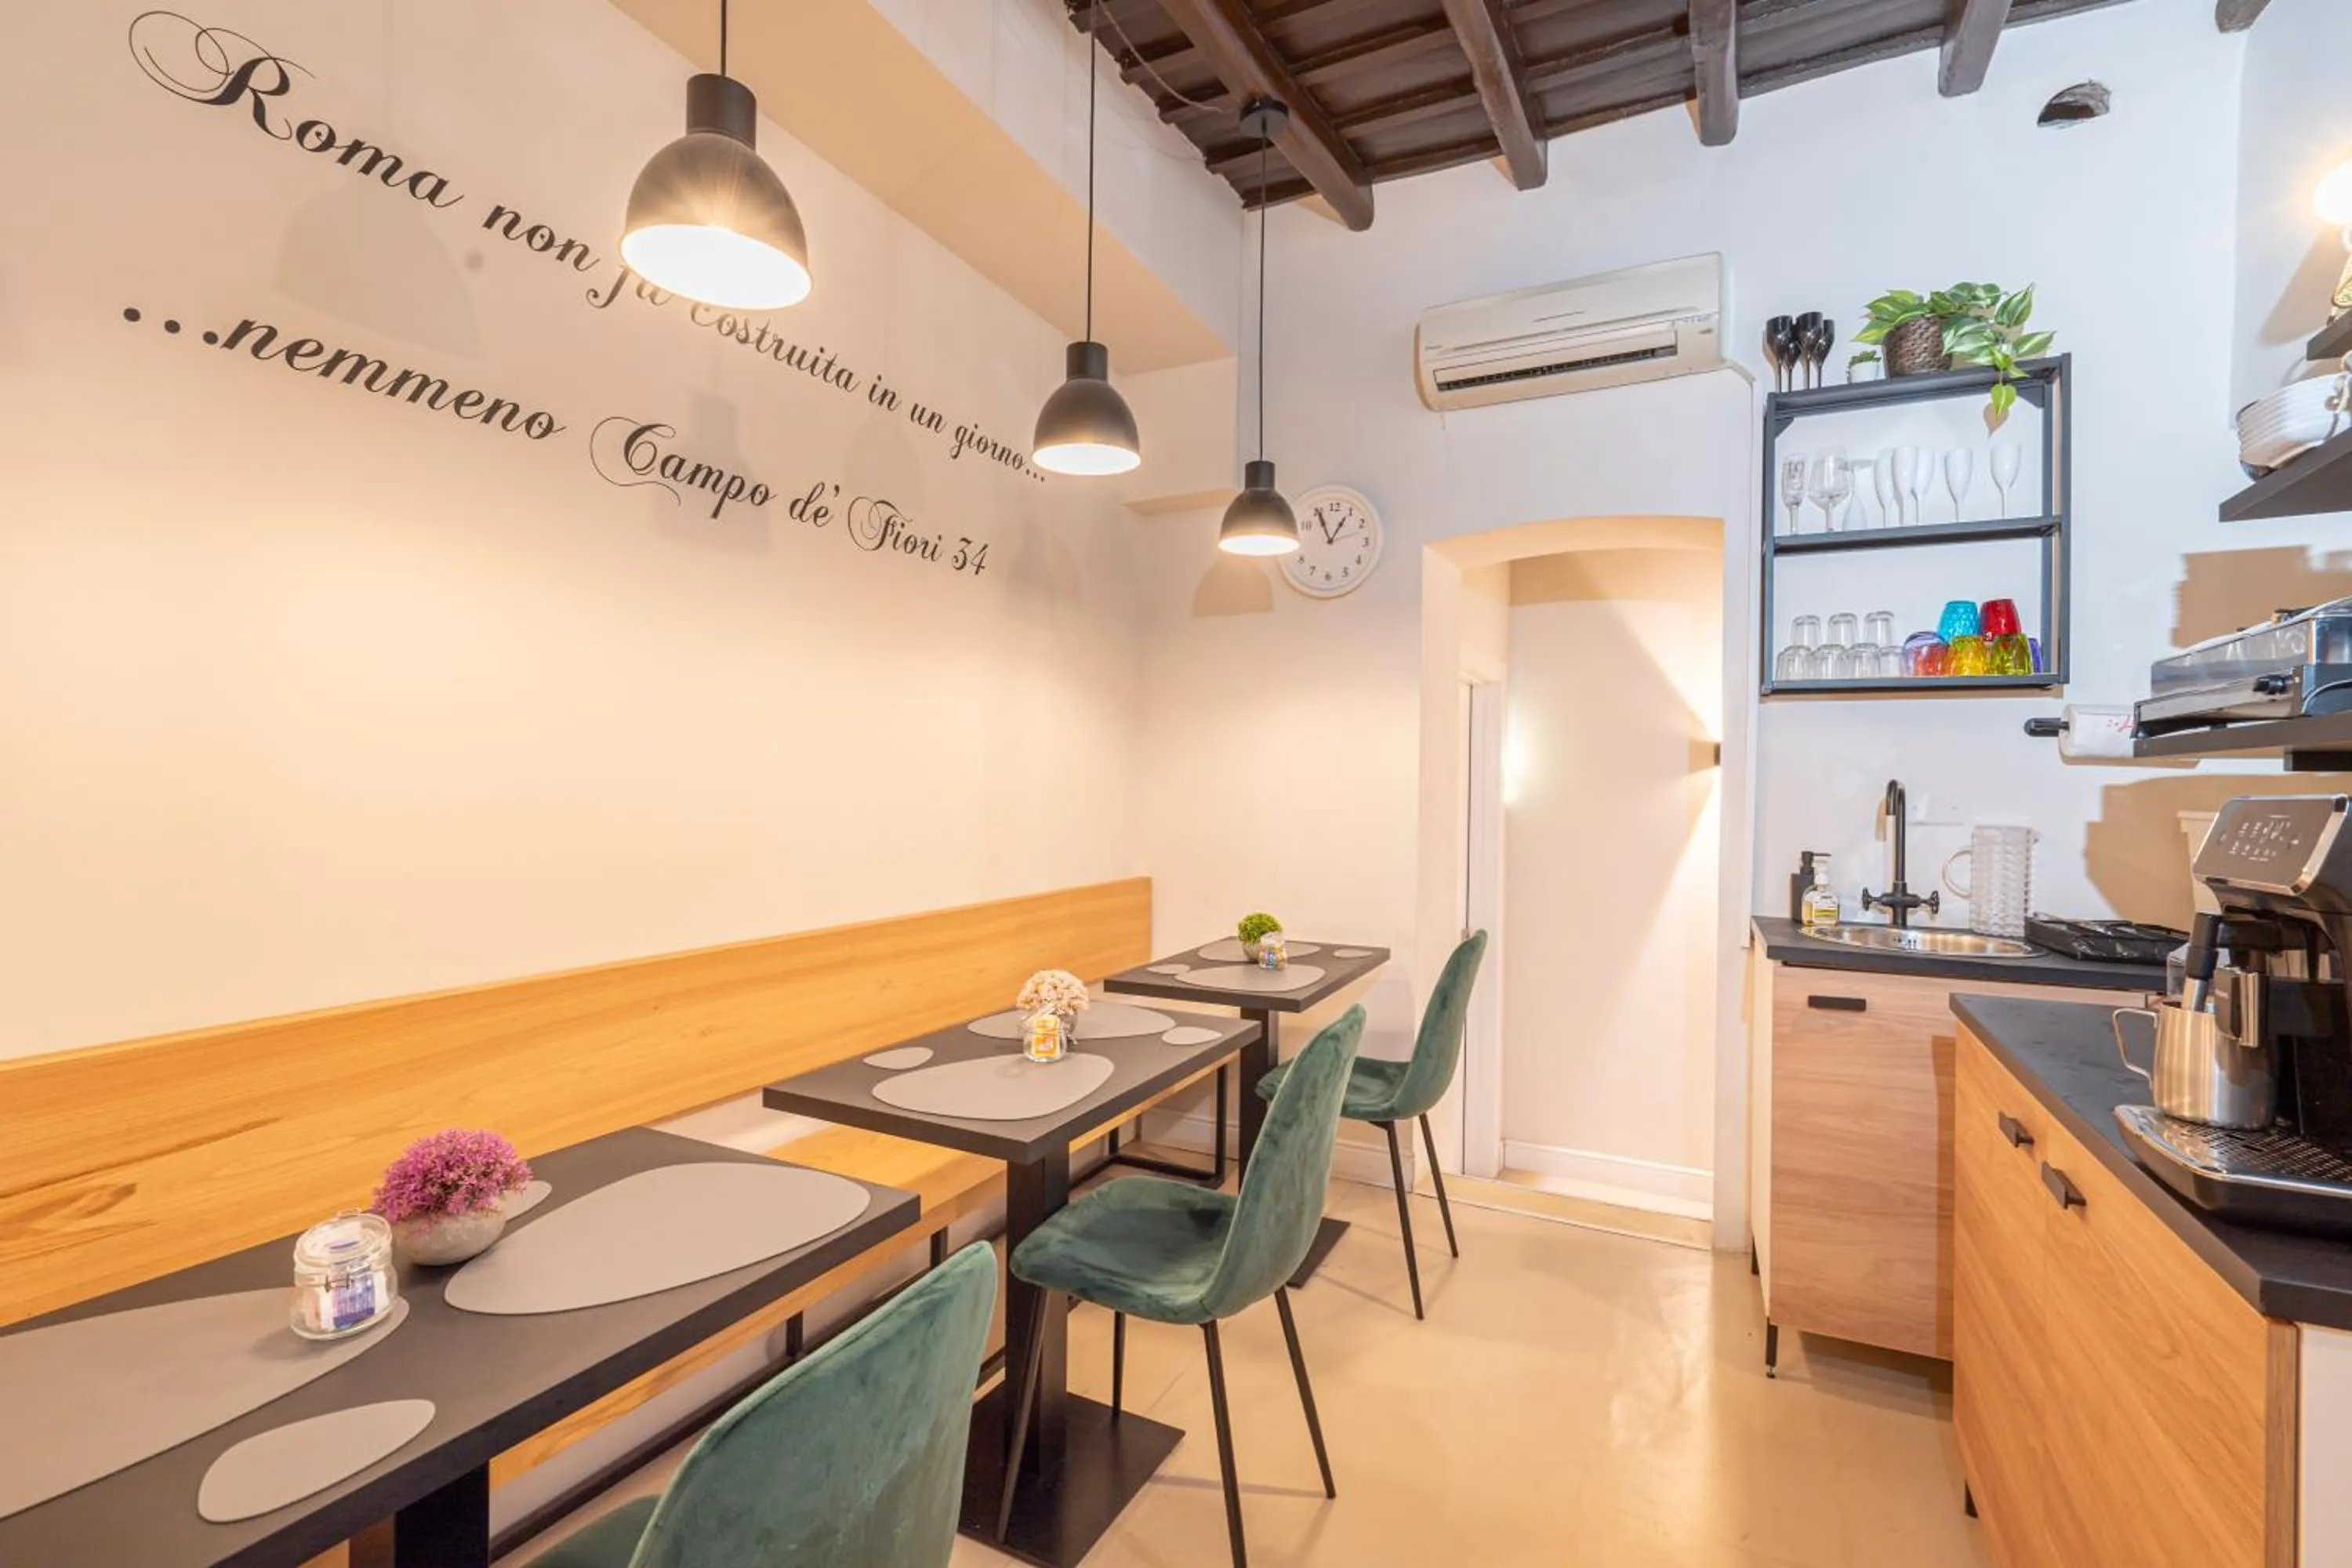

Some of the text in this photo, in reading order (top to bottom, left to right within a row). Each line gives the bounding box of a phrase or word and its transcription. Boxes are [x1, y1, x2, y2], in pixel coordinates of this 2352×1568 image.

[129, 10, 465, 208] Roma
[481, 204, 601, 272] non
[689, 301, 861, 393] costruita
[868, 374, 903, 412] in
[909, 403, 947, 434] un
[949, 423, 1045, 482] giorno...
[590, 416, 779, 519] Campo
[848, 496, 942, 562] Fiori
[952, 537, 989, 575] 34
[1329, 502, 1341, 512] 12
[1347, 506, 1353, 517] 1
[1359, 517, 1366, 529] 2
[1362, 537, 1369, 548] 3
[1309, 565, 1316, 576] 7
